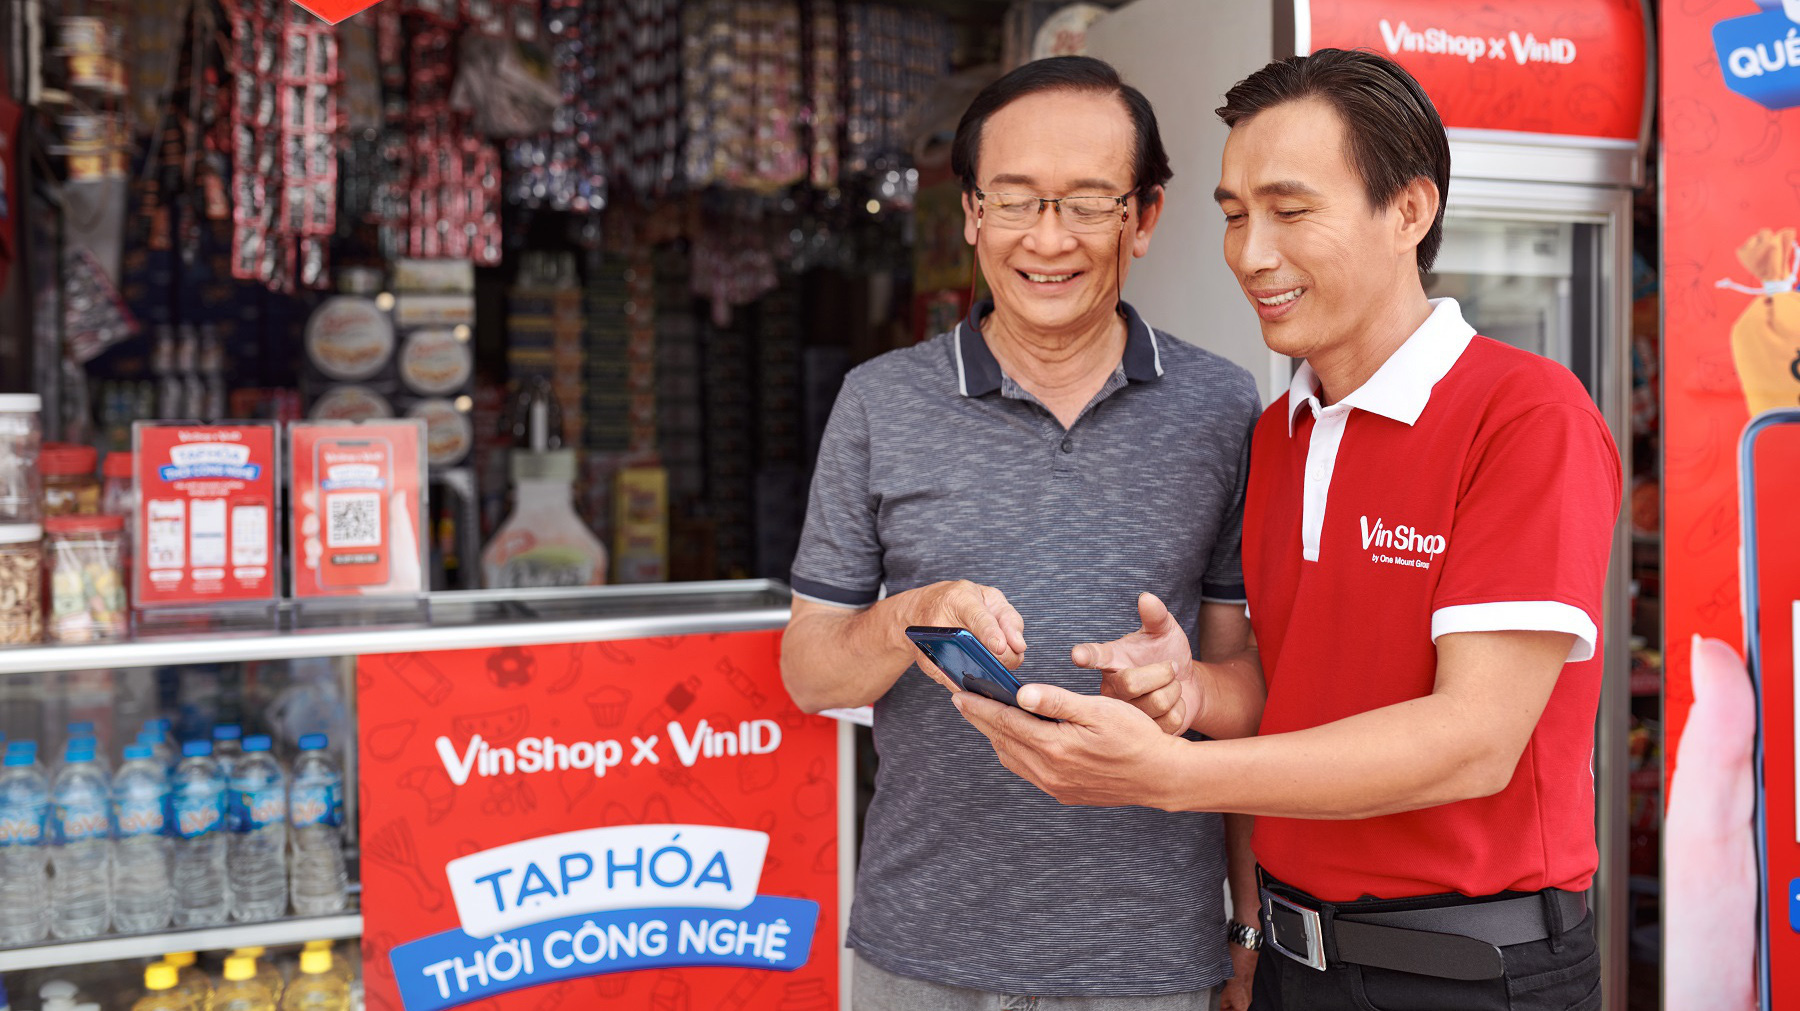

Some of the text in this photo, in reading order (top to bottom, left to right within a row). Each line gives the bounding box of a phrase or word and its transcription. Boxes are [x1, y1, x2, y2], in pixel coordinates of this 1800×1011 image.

[1379, 19, 1576, 65] VinShop x VinID
[1371, 553, 1379, 563] by
[1380, 554, 1393, 564] One
[1394, 556, 1415, 567] Mount
[435, 719, 782, 786] VinShop x VinID
[475, 833, 732, 911] TẠP HÓA
[422, 918, 791, 999] THỜI CÔNG NGHỆ
